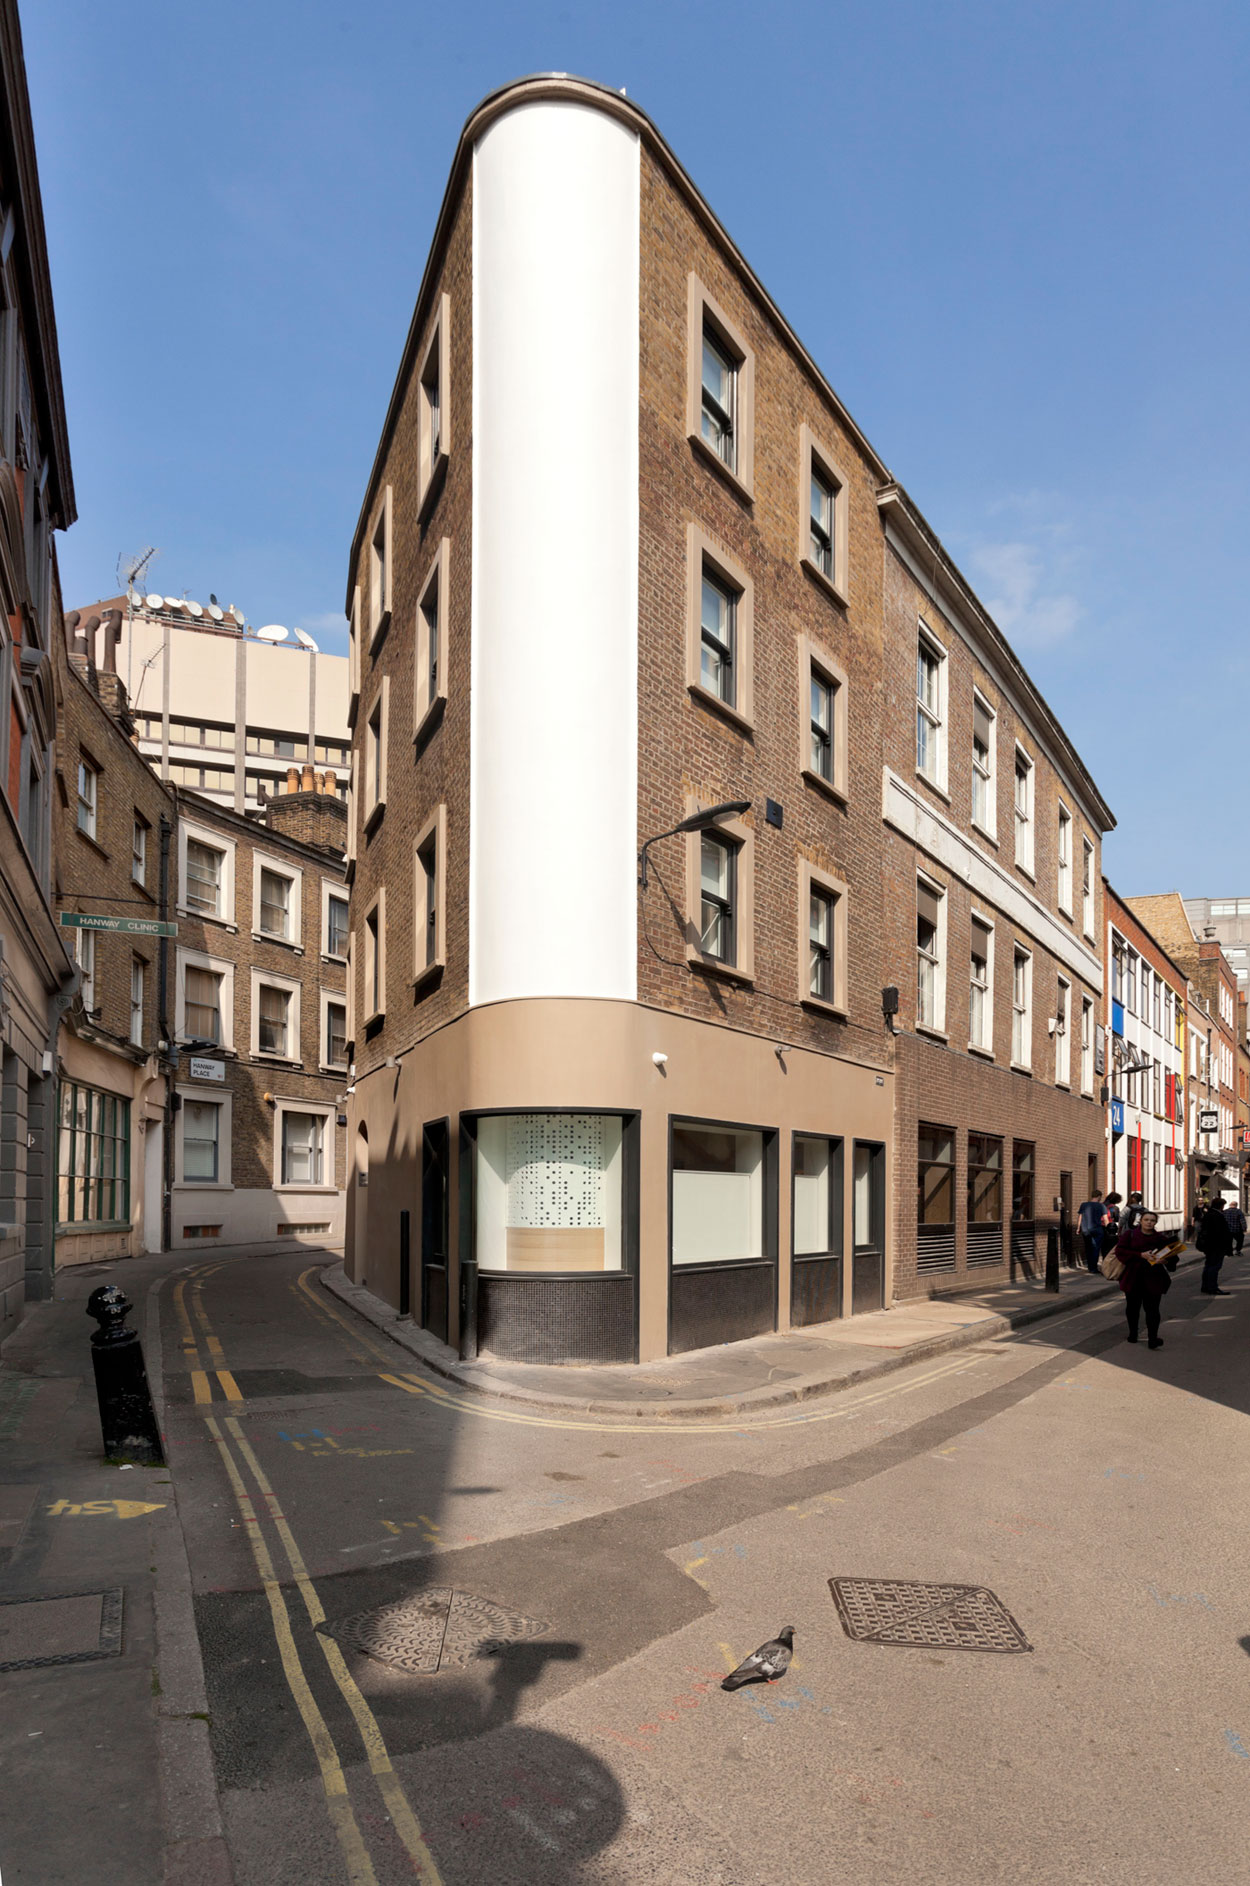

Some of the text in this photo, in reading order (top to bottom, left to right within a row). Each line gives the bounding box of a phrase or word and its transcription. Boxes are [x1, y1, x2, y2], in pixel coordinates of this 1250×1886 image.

[79, 917, 159, 932] HANWAY CLINIC
[192, 1062, 215, 1071] HANWAY
[192, 1069, 210, 1077] PLACE
[1112, 1104, 1121, 1127] 24
